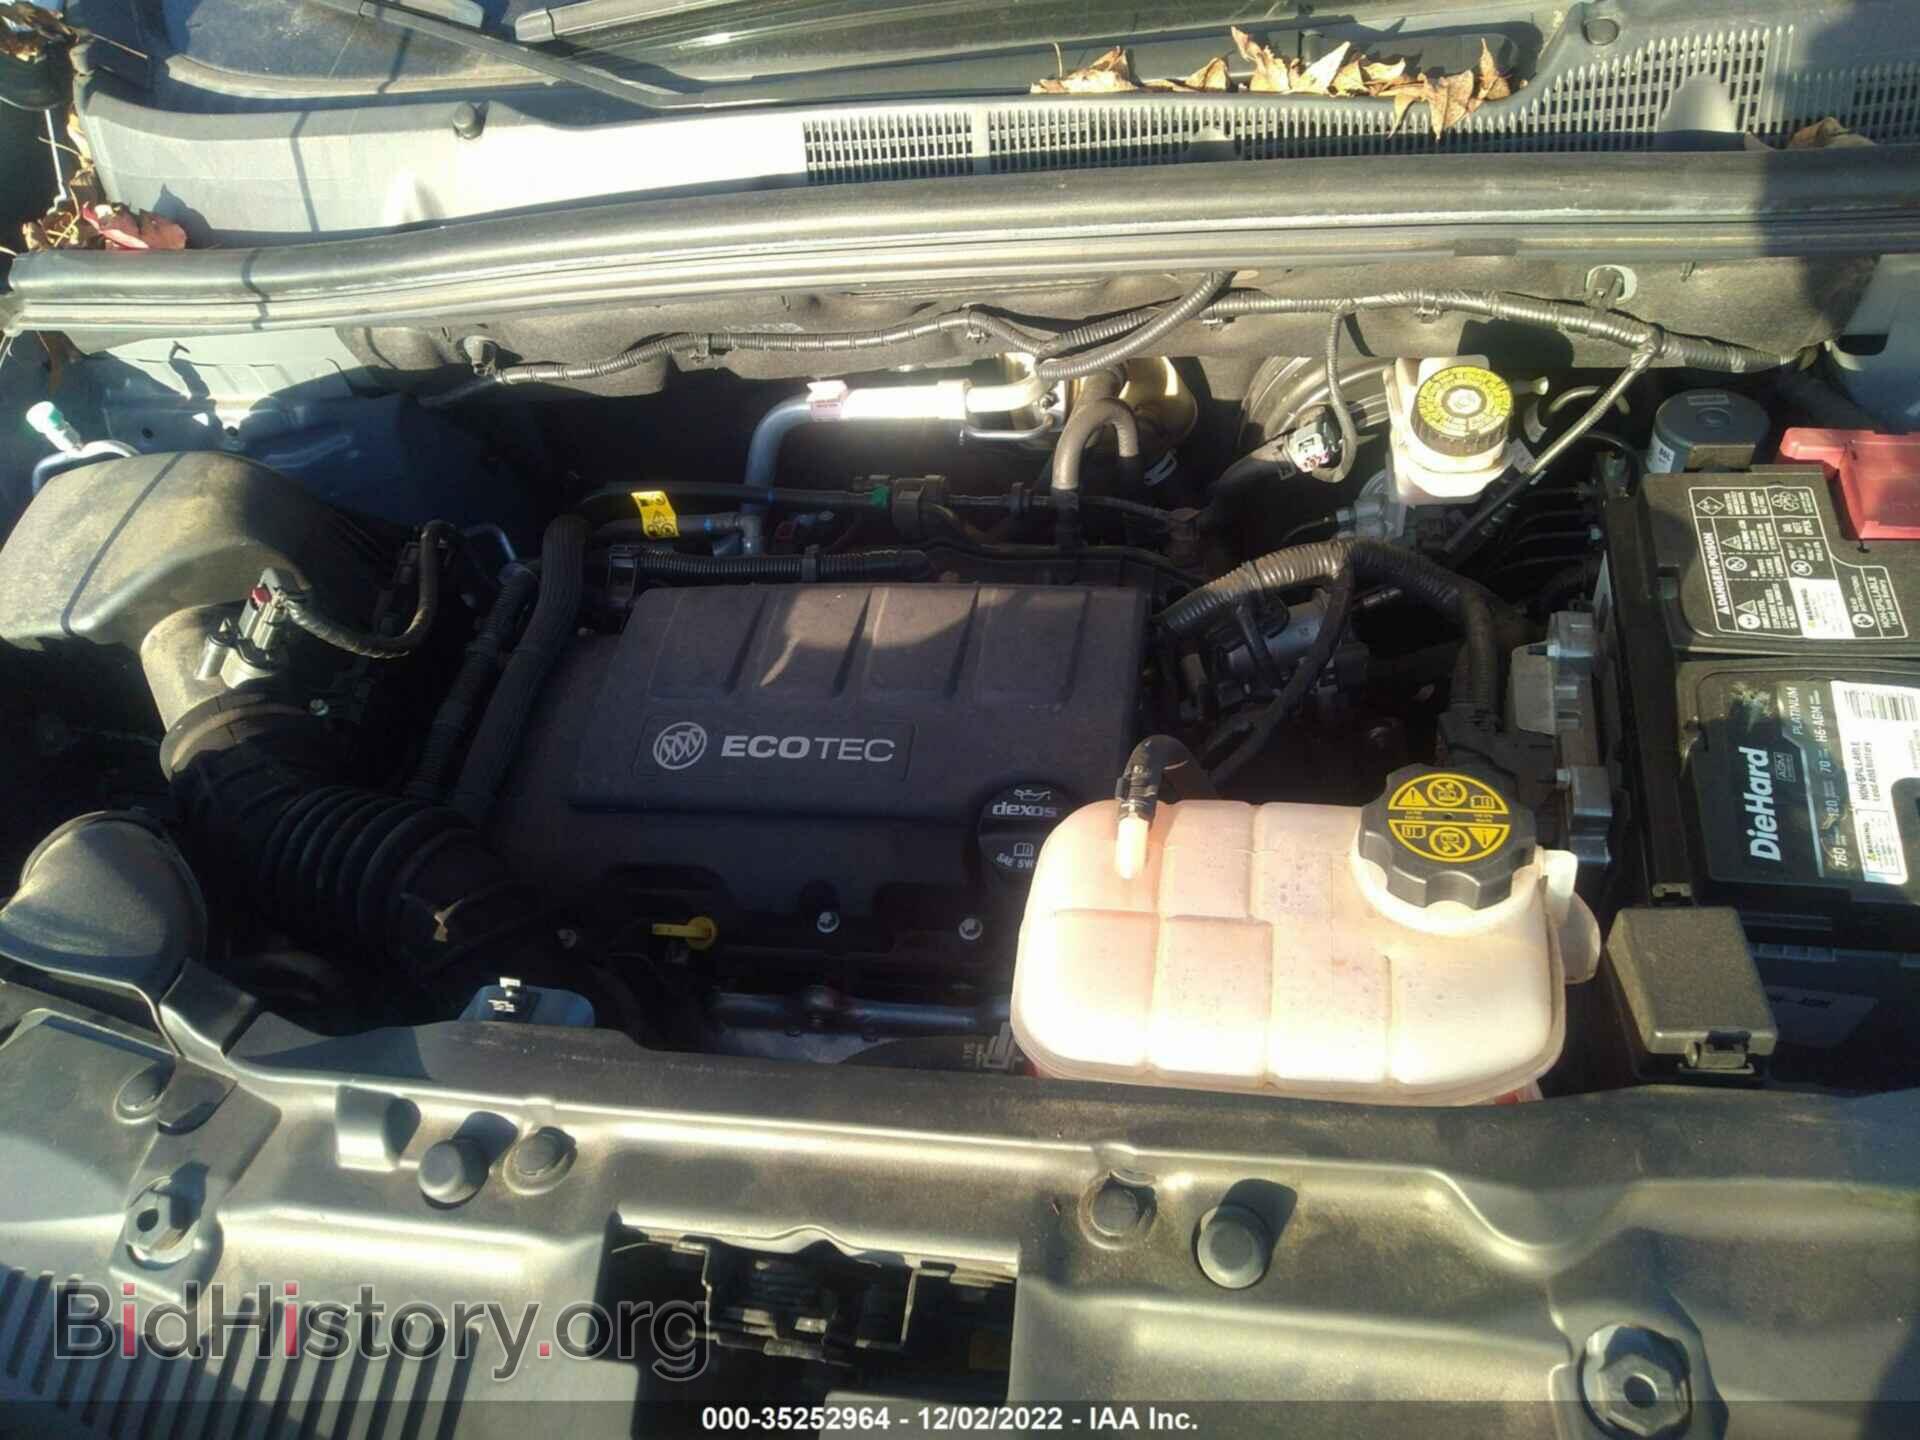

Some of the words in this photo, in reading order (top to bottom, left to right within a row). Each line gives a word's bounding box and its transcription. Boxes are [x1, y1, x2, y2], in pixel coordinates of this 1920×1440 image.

[1703, 532, 1729, 607] DANGER/POISON
[1785, 686, 1803, 736] PLATINUM
[721, 735, 896, 762] ECOTEC
[1775, 753, 1787, 779] AGM
[1820, 760, 1832, 773] 70
[992, 801, 1057, 817] dexos
[1739, 746, 1781, 861] DieHard
